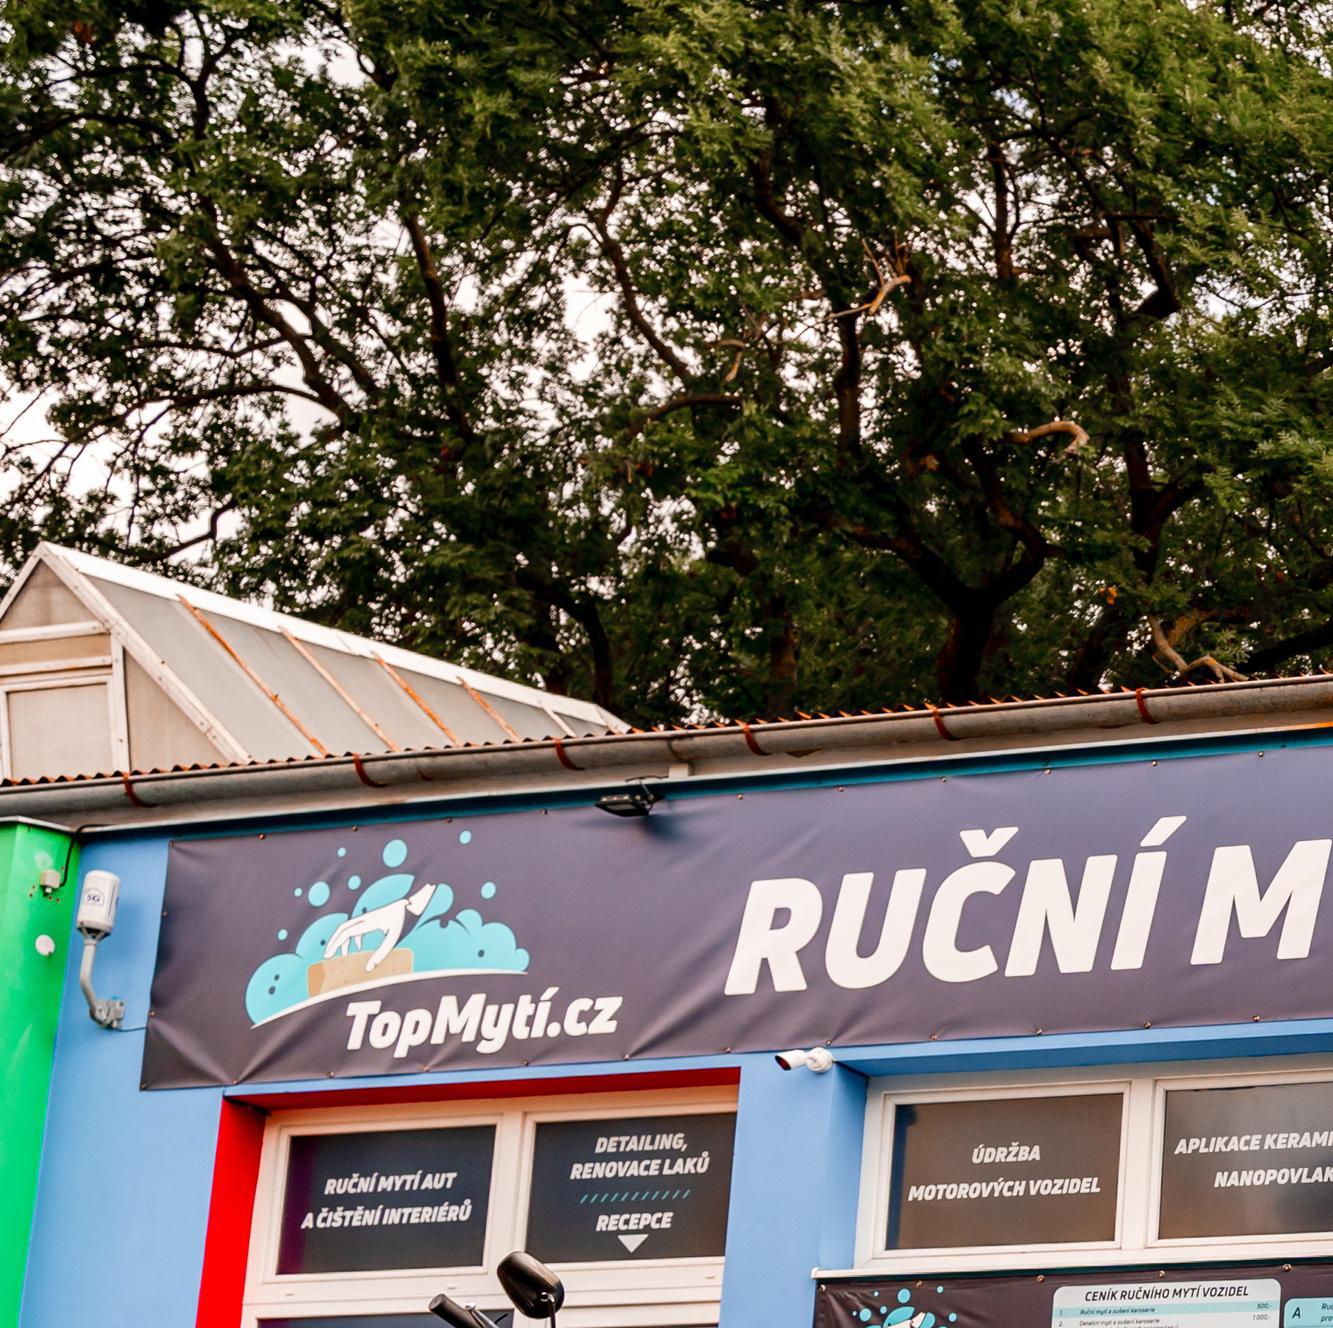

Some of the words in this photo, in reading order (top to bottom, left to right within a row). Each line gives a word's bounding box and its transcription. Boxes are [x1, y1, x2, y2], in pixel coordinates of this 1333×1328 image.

[724, 816, 1187, 996] RUČNÍ
[345, 986, 623, 1058] TopMytí.cz
[594, 1132, 688, 1154] DETAILING,
[971, 1141, 1041, 1164] ÚDRŽBA
[1173, 1134, 1262, 1155] APLIKACE
[569, 1159, 662, 1180] RENOVACE
[662, 1150, 710, 1175] LAKŮ
[324, 1172, 379, 1195] RUČNÍ
[376, 1169, 423, 1192] MYTÍ
[420, 1172, 458, 1190] AUT
[907, 1177, 1027, 1202] MOTOROVÝCH
[1029, 1177, 1101, 1196] VOZIDEL
[300, 1212, 314, 1229] A
[316, 1204, 384, 1229] ČIŠTĚNÍ
[382, 1198, 473, 1225] INTERIÉRŮ
[595, 1211, 674, 1232] RECEPCE
[1084, 1288, 1119, 1302] CENÍK
[1119, 1286, 1170, 1301] RUČNÍHO
[1171, 1284, 1202, 1298] MYTÍ
[1202, 1285, 1249, 1298] VOZIDEL
[1292, 1307, 1301, 1319] A
